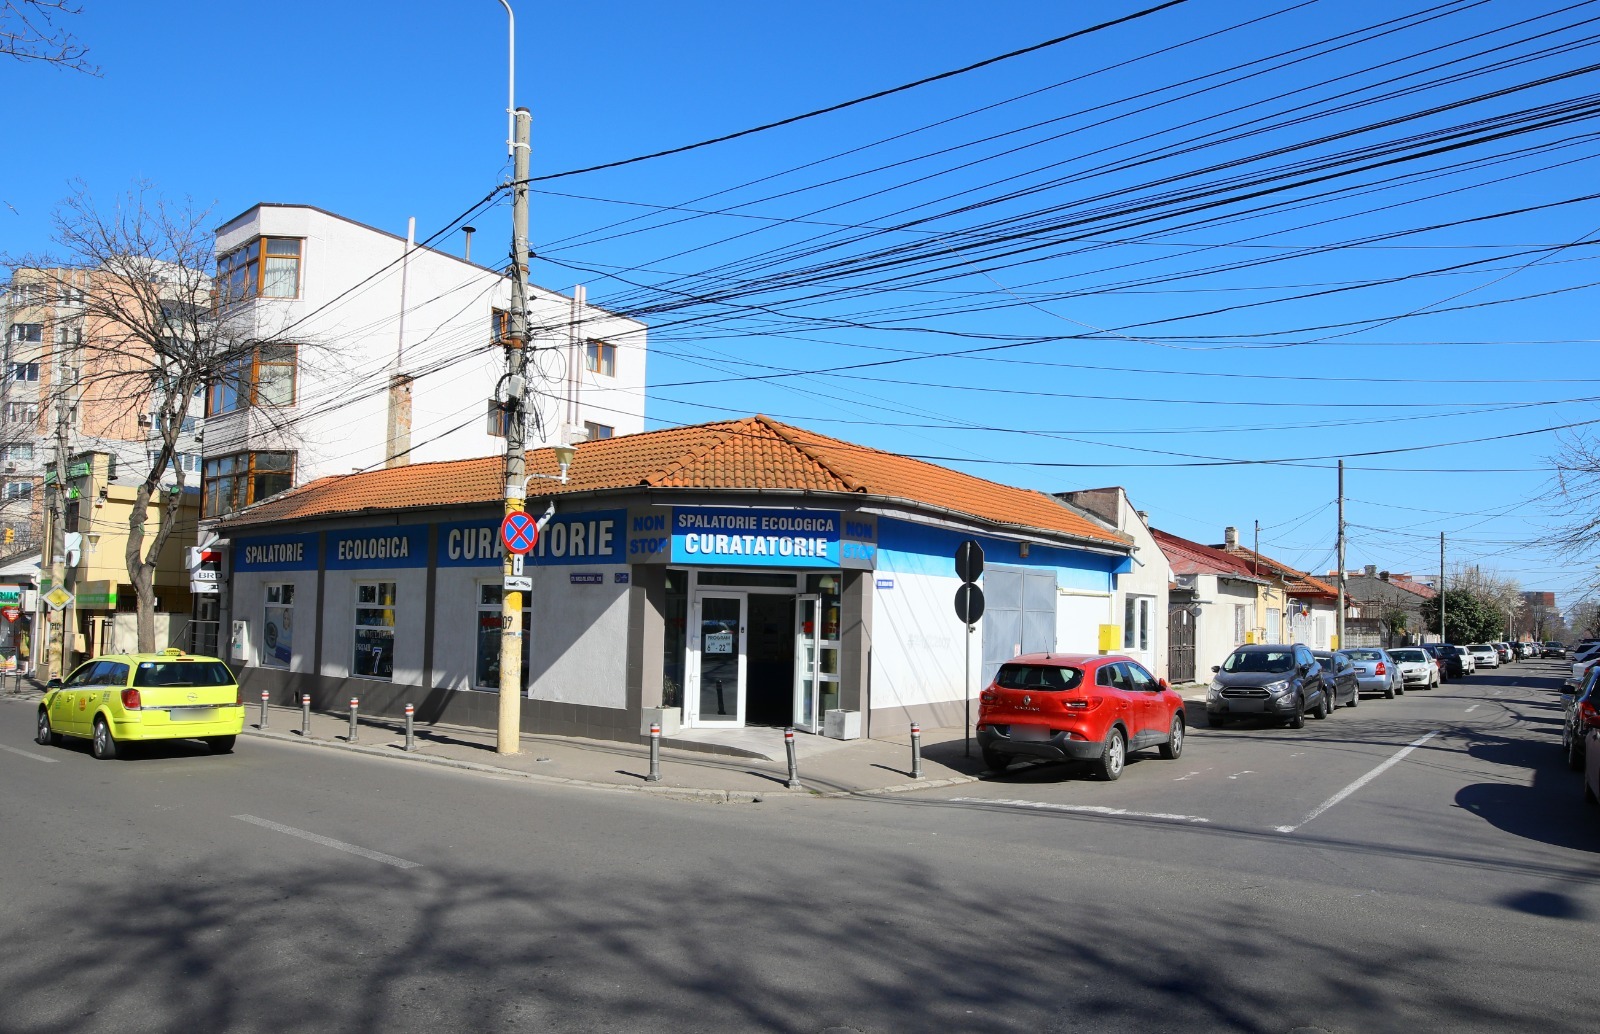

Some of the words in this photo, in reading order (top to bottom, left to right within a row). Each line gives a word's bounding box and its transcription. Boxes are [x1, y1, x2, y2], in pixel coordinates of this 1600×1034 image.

[633, 514, 665, 532] NON
[678, 514, 757, 530] SPALATORIE
[761, 516, 834, 532] ECOLOGICA
[845, 520, 873, 539] NON
[245, 543, 304, 564] SPALATORIE
[338, 536, 409, 560] ECOLOGICA
[448, 520, 614, 560] CURATORIE
[630, 537, 667, 554] STOP
[685, 533, 828, 557] CURATATORIE
[843, 542, 875, 560] STOP
[372, 646, 382, 674] 7
